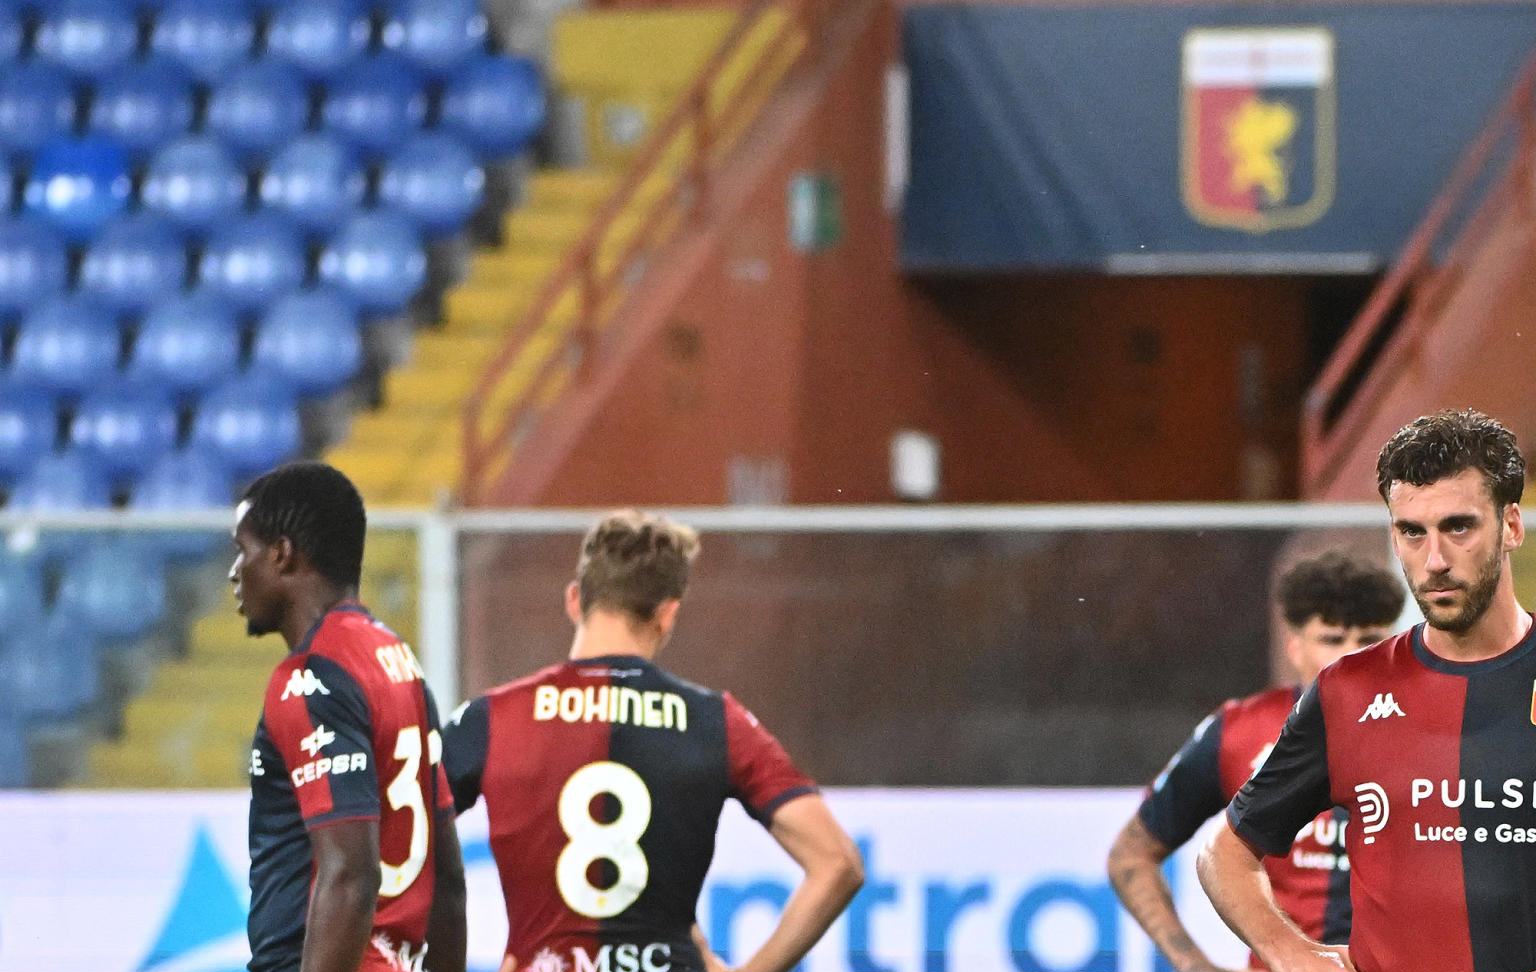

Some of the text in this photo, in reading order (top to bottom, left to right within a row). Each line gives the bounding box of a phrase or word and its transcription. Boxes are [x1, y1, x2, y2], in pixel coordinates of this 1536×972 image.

[533, 684, 688, 732] BOHINEN
[291, 752, 368, 788] CEPSA
[556, 760, 652, 918] 8
[1414, 822, 1468, 842] Luce
[1474, 827, 1489, 843] e
